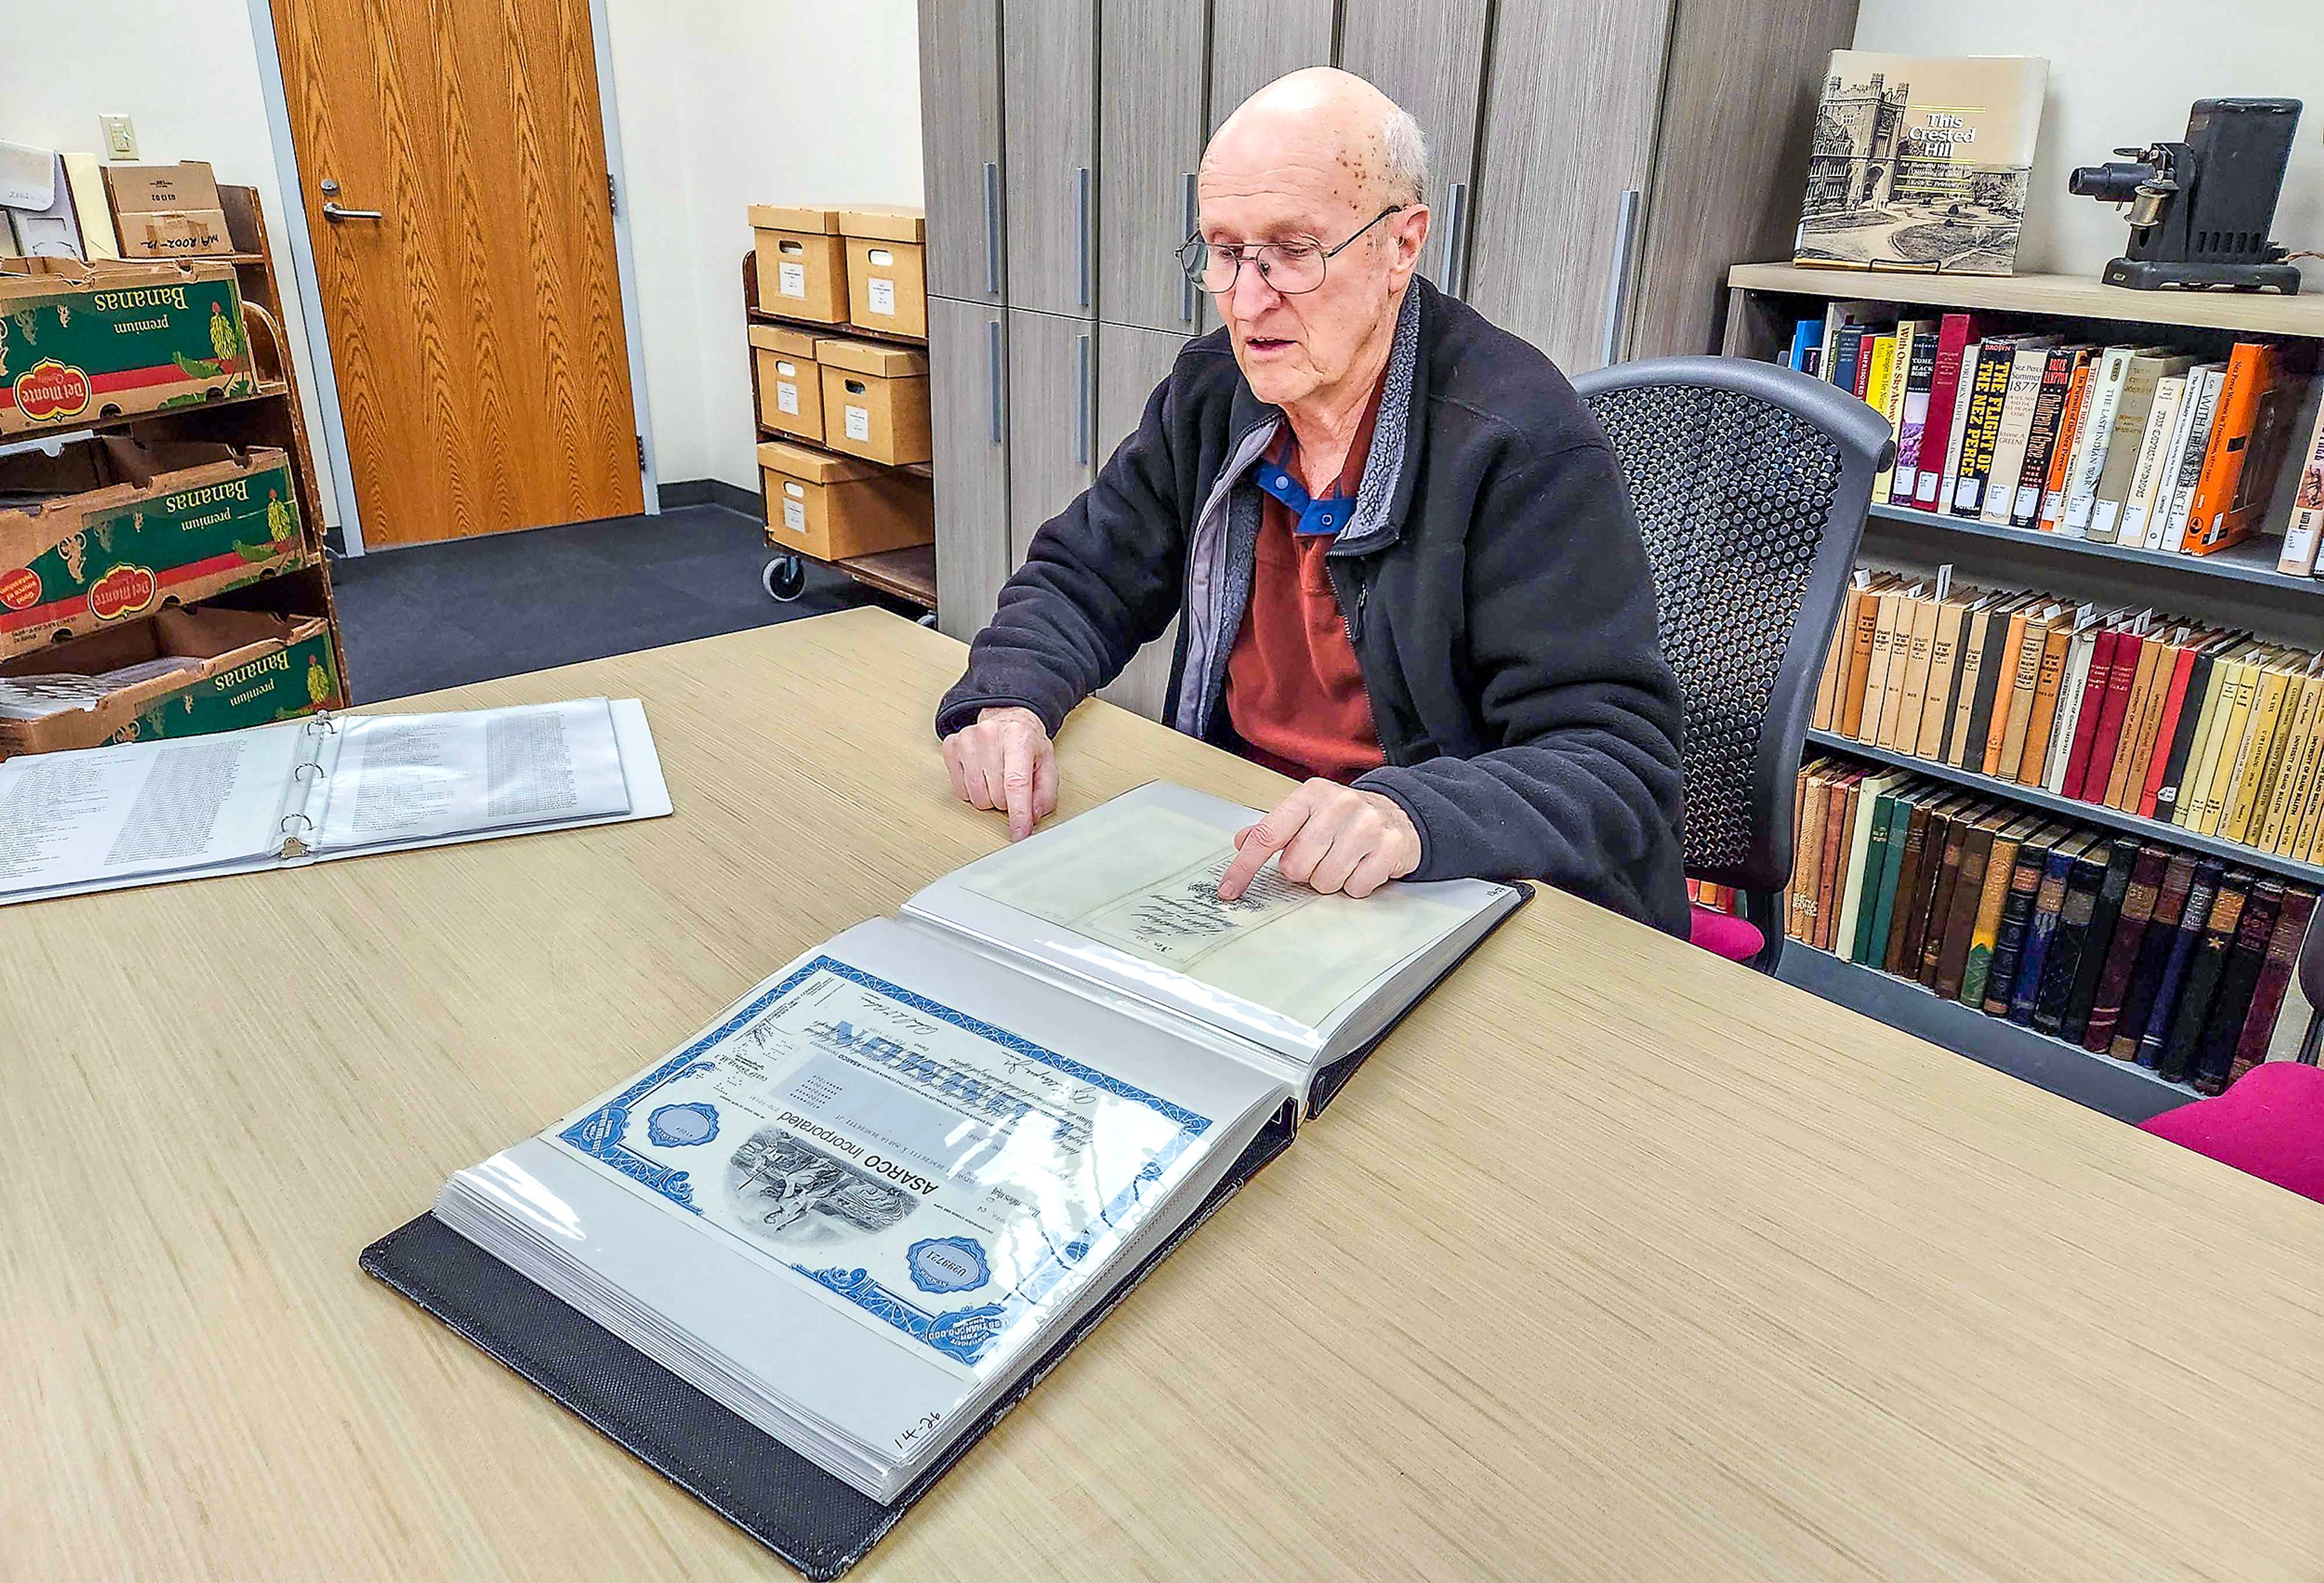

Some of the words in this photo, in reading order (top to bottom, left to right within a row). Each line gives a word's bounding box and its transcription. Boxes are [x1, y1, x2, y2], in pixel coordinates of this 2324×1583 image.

[1926, 113, 1963, 128] This
[1908, 126, 1976, 143] Crested
[1924, 142, 1954, 157] Hill
[94, 286, 189, 314] Bananas
[113, 315, 170, 335] premium
[1897, 326, 1910, 350] With
[1984, 342, 2011, 352] BROWN
[1855, 349, 1873, 396] IMPRISONED
[1880, 348, 1894, 373] Stranger
[1894, 350, 1906, 372] One
[2233, 360, 2242, 374] Nez
[1879, 379, 1889, 392] Her
[1888, 370, 1904, 393] Sky
[1957, 358, 1973, 399] FORLORN
[1974, 358, 1996, 393] THE
[1989, 359, 2011, 395] THE
[2011, 372, 2040, 381] Summer
[2044, 371, 2068, 385] HAMPTON
[2077, 375, 2086, 384] In
[2088, 366, 2098, 382] THE
[2191, 375, 2199, 386] The
[2228, 373, 2239, 392] Perce
[21, 385, 62, 403] Monte
[63, 381, 84, 398] Del
[2010, 381, 2038, 392] 1877
[2070, 384, 2084, 412] Pursuit
[2081, 382, 2094, 410] GREAT
[2102, 387, 2115, 408] THE
[1876, 392, 1888, 410] Native
[1884, 390, 1900, 421] Above
[1953, 399, 1965, 423] HOPE
[1968, 393, 1988, 426] NEZ
[2034, 391, 2061, 428] Children
[2181, 385, 2196, 418] Intermediary
[2194, 392, 2214, 428] WITH
[2222, 391, 2234, 416] Women
[1978, 396, 2003, 451] FLIGHT
[2066, 421, 2075, 434] the
[2069, 411, 2078, 421] of
[2073, 410, 2088, 445] RETREAT
[2096, 407, 2110, 431] LAST
[2153, 409, 2167, 430] THE
[2220, 415, 2228, 424] in
[2033, 425, 2054, 437] of
[2063, 433, 2072, 448] Nez
[2188, 427, 2205, 450] THE
[2210, 421, 2227, 456] Transition,
[1958, 428, 1983, 477] PERCE
[2027, 434, 2053, 461] Grace
[2089, 431, 2106, 465] INDIAN
[2145, 428, 2162, 462] CAYUSE
[1975, 453, 1992, 474] OF
[2056, 447, 2069, 473] Perces
[2181, 451, 2198, 476] NEZ
[2083, 465, 2096, 487] WAR
[2136, 462, 2153, 499] INDIANS
[165, 479, 250, 514] Bananas
[2171, 477, 2191, 512] PERCE
[2196, 493, 2206, 510] James
[181, 507, 232, 534] premium
[15, 589, 35, 607] Good
[214, 649, 290, 693] Bananas
[229, 679, 275, 709] premium
[2072, 678, 2083, 706] UNIVERSITY
[2130, 685, 2142, 714] UNIVERSITY
[2129, 714, 2135, 723] OF
[2148, 693, 2160, 721] UNIVERSITY
[2050, 721, 2061, 749] UNIVERSITY
[2287, 734, 2301, 764] UNIVERSITY
[2305, 735, 2319, 765] UNIVERSITY
[2285, 764, 2292, 773] OF
[2280, 773, 2290, 791] IDAHO
[2297, 773, 2308, 793] IDAHO
[2314, 774, 2324, 793] IDAHO
[2273, 791, 2285, 814] BULLETIN
[2290, 792, 2303, 816] BULLETIN
[2308, 792, 2320, 816] BULLETIN
[836, 1053, 864, 1067] ASARCO
[773, 1109, 868, 1160] Incorporated
[859, 1152, 940, 1197] ASARCO
[922, 1250, 969, 1277] U299721
